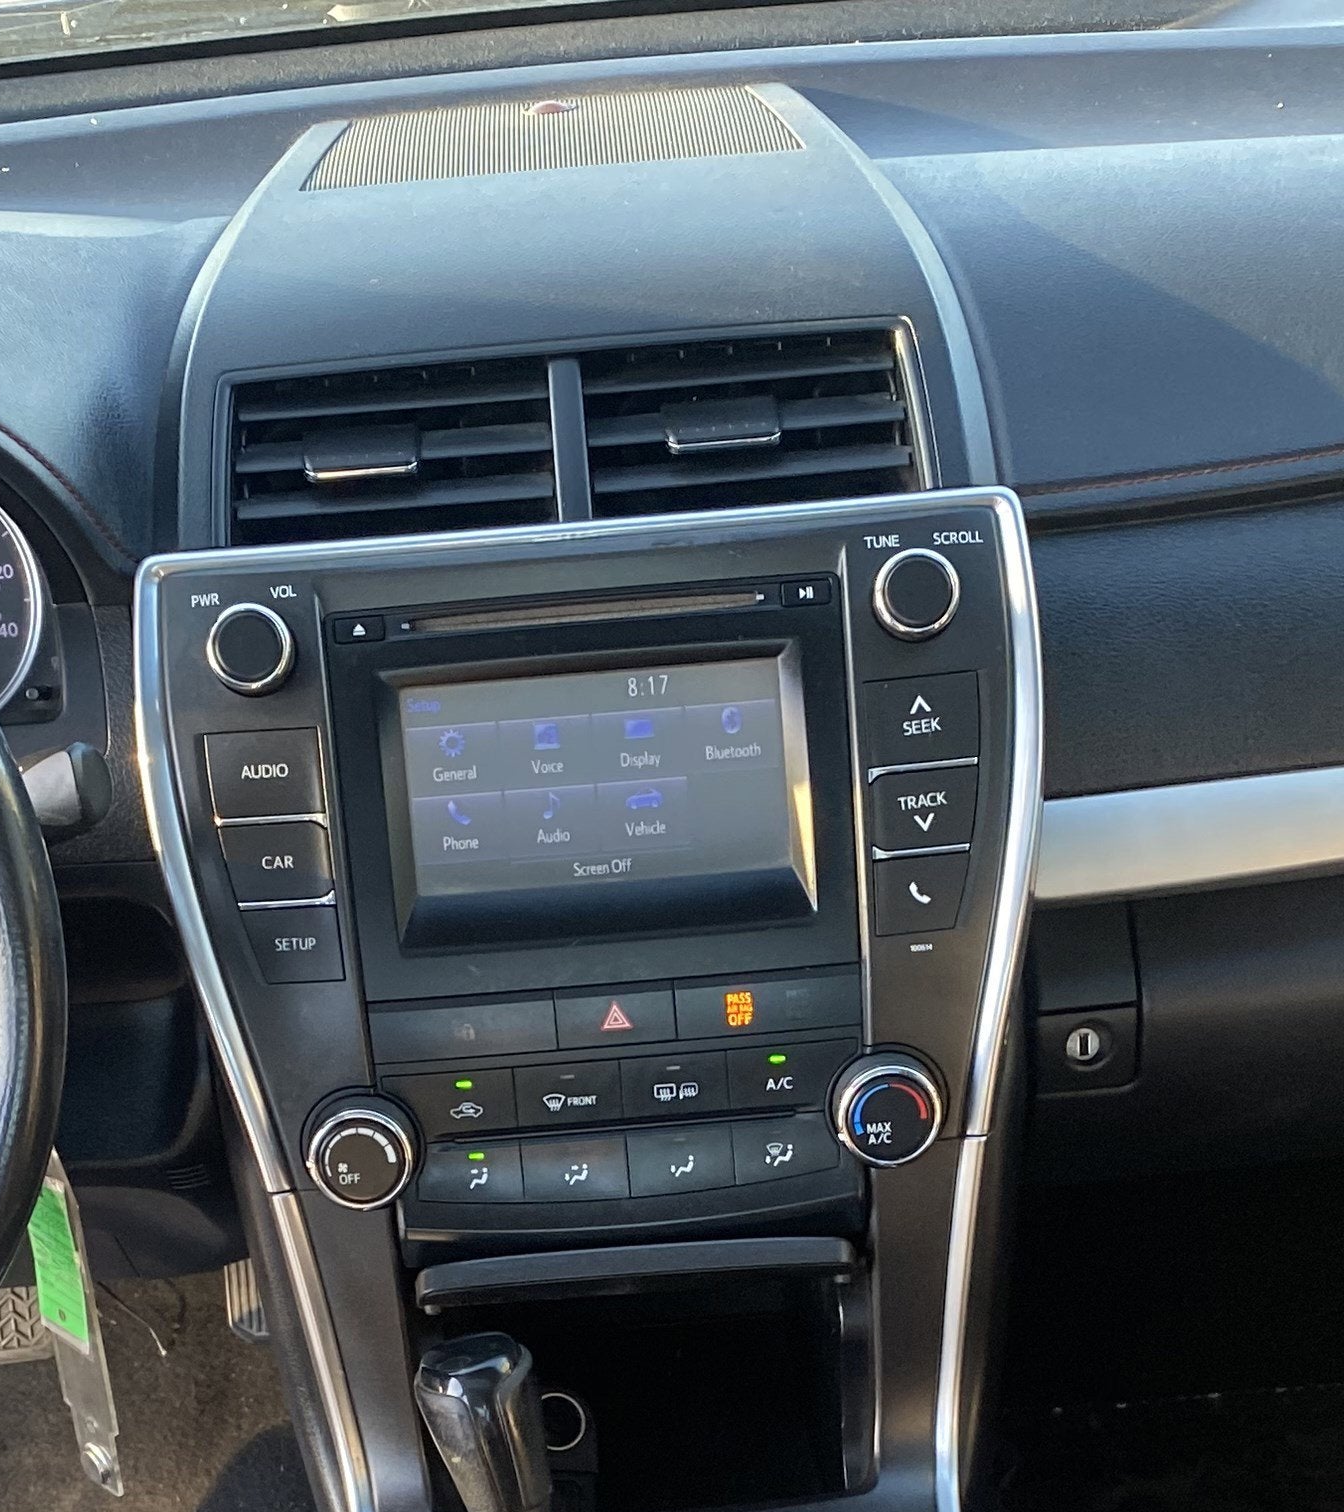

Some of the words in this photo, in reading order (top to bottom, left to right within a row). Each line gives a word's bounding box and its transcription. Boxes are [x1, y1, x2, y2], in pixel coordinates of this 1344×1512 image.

[864, 534, 900, 550] TUNE
[932, 530, 984, 546] SCROLL
[191, 593, 220, 607] PWR
[270, 585, 297, 599] VOL
[627, 675, 669, 697] 8:17
[903, 716, 942, 736] SEEK
[620, 752, 661, 768] Display
[705, 743, 761, 761] Bluetooth
[241, 763, 289, 779] AUDIO
[433, 766, 477, 782] General
[531, 759, 564, 775] Voice
[897, 791, 947, 811] TRACK
[537, 829, 570, 844] Audio
[625, 820, 667, 837] Vehicle
[442, 836, 479, 851] Phone
[261, 855, 294, 870] CAR
[573, 861, 609, 877] Screen
[611, 858, 632, 874] Off
[274, 937, 317, 951] SETUP
[726, 991, 752, 1004] PASS
[727, 1013, 753, 1026] OFF
[765, 1076, 794, 1091] A/C
[567, 1095, 597, 1106] FRONT
[866, 1121, 892, 1134] MAX
[868, 1132, 892, 1145] A/C
[339, 1173, 360, 1185] OFF
